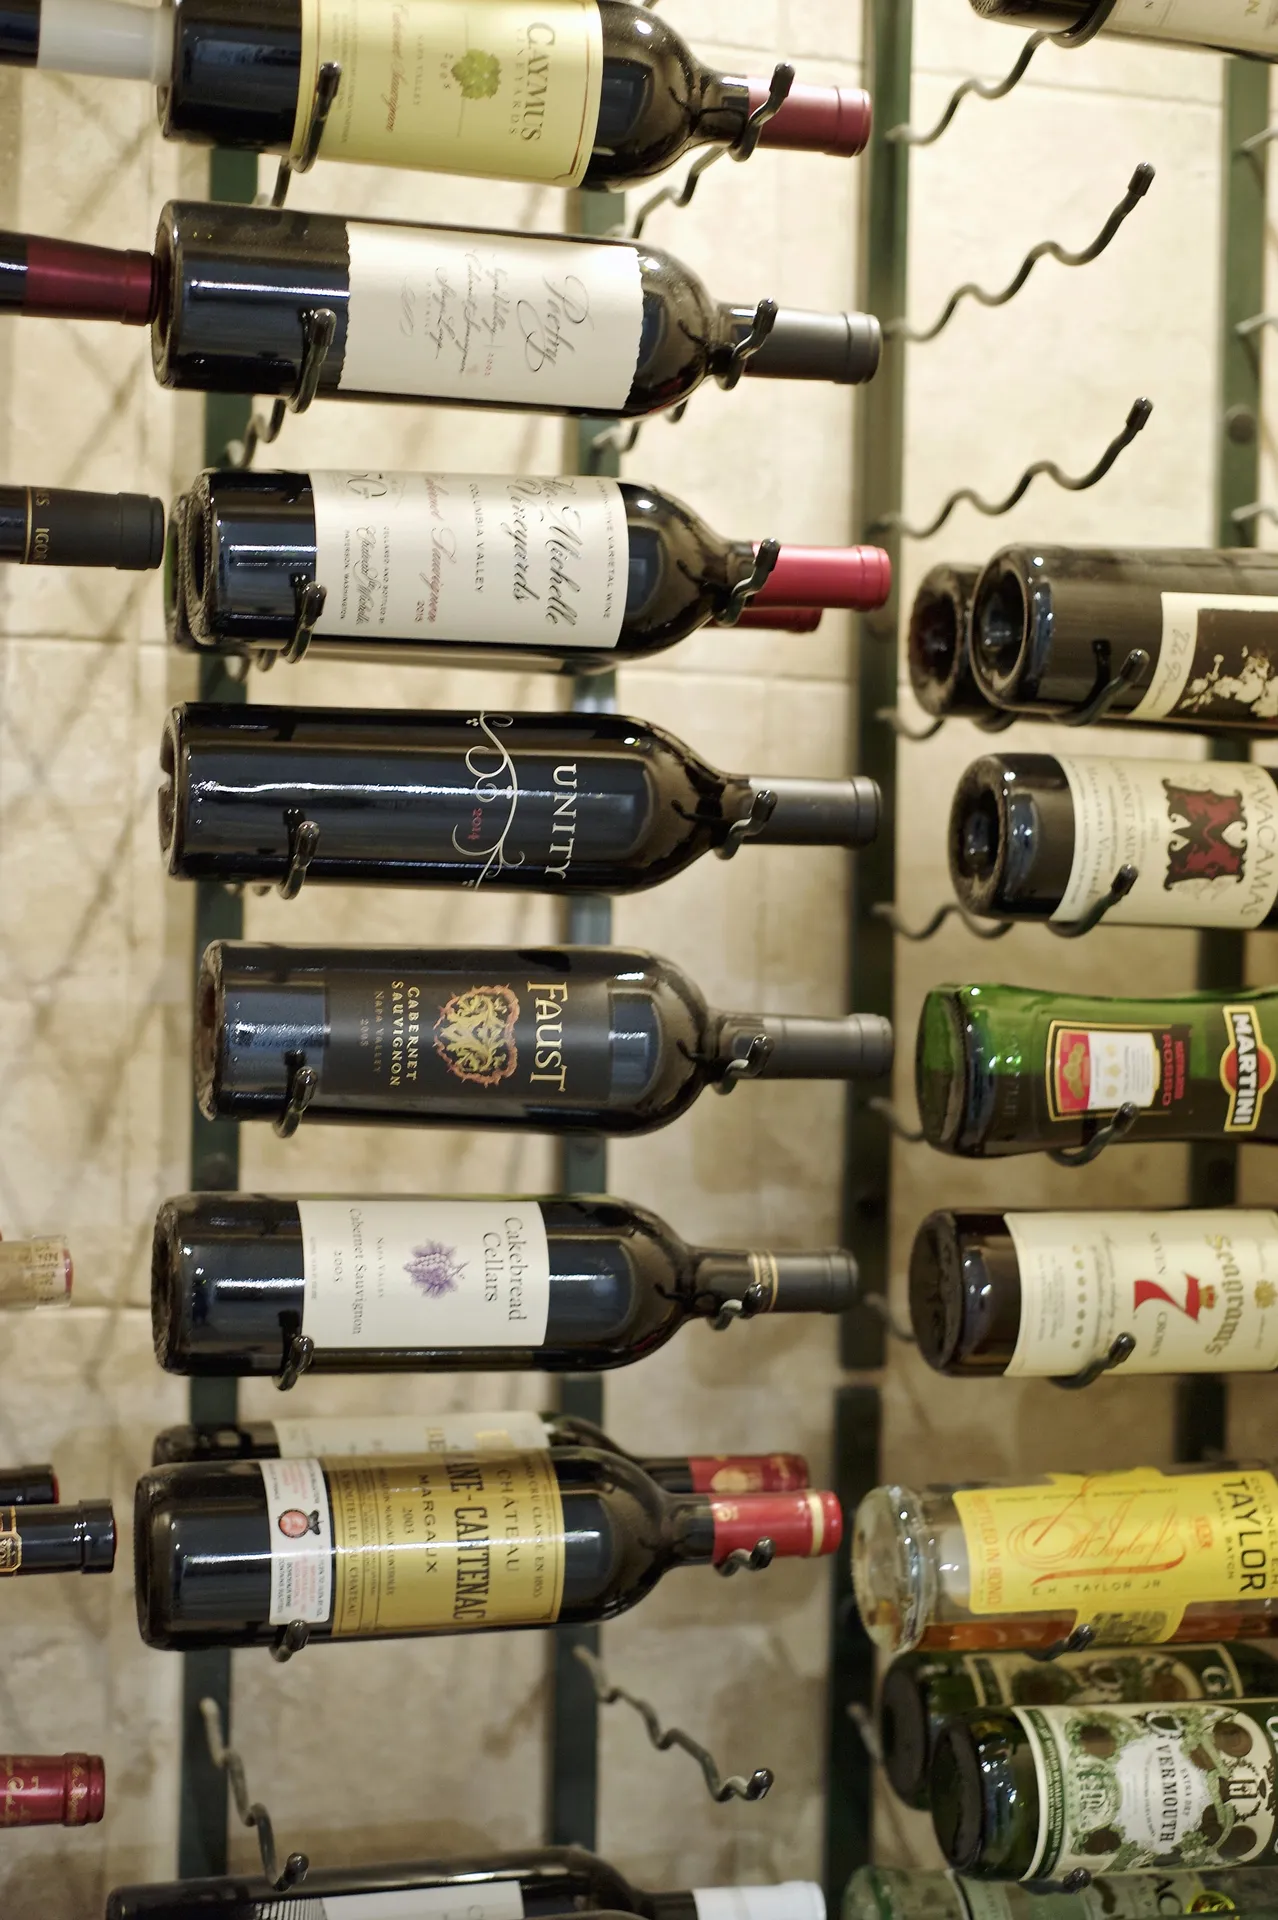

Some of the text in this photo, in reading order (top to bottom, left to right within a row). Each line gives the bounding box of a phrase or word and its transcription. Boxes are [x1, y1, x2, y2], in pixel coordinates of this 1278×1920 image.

[381, 62, 409, 132] Sauvignon
[413, 65, 424, 106] VALLEY
[509, 28, 526, 135] VINEYARDS
[520, 22, 556, 141] CAYMUS
[517, 275, 594, 372] Poetry
[382, 568, 390, 583] AND
[419, 527, 457, 624] Sauvignon
[469, 483, 485, 594] COLUMBIA VALLEY
[500, 478, 545, 604] Vineyards
[544, 501, 583, 627] Michelle
[606, 536, 616, 588] VARIETAL
[339, 573, 350, 621] WASHINGTON
[379, 585, 388, 615] BOTTLED
[602, 592, 613, 619] WINE
[467, 808, 483, 840] 2014
[544, 763, 578, 880] UNITY
[373, 991, 386, 1074] NAPA VALLEY
[389, 980, 404, 1087] SAUVIGNON
[405, 986, 421, 1081] CABERNET
[527, 980, 568, 1093] FAUST
[1232, 1014, 1256, 1125] MARTINI
[348, 1208, 368, 1335] Cabernet Sauvignon
[482, 1232, 504, 1303] Cellars
[504, 1217, 529, 1321] Cakebread
[1133, 1271, 1201, 1324] 7
[1149, 1311, 1168, 1358] CROWN
[417, 1474, 437, 1574] MARGAUX
[496, 1468, 521, 1573] CHÂTEAU
[535, 1556, 544, 1573] EN
[985, 1548, 1002, 1563] IN
[1212, 1490, 1235, 1580] SMALL BATCH
[1221, 1477, 1266, 1593] TAYLOR
[987, 1566, 1004, 1606] BOND
[1074, 1580, 1132, 1594] TAYLOR
[1156, 1744, 1178, 1843] VERMOUTH
[1180, 1768, 1193, 1817] EXTRA DRY
